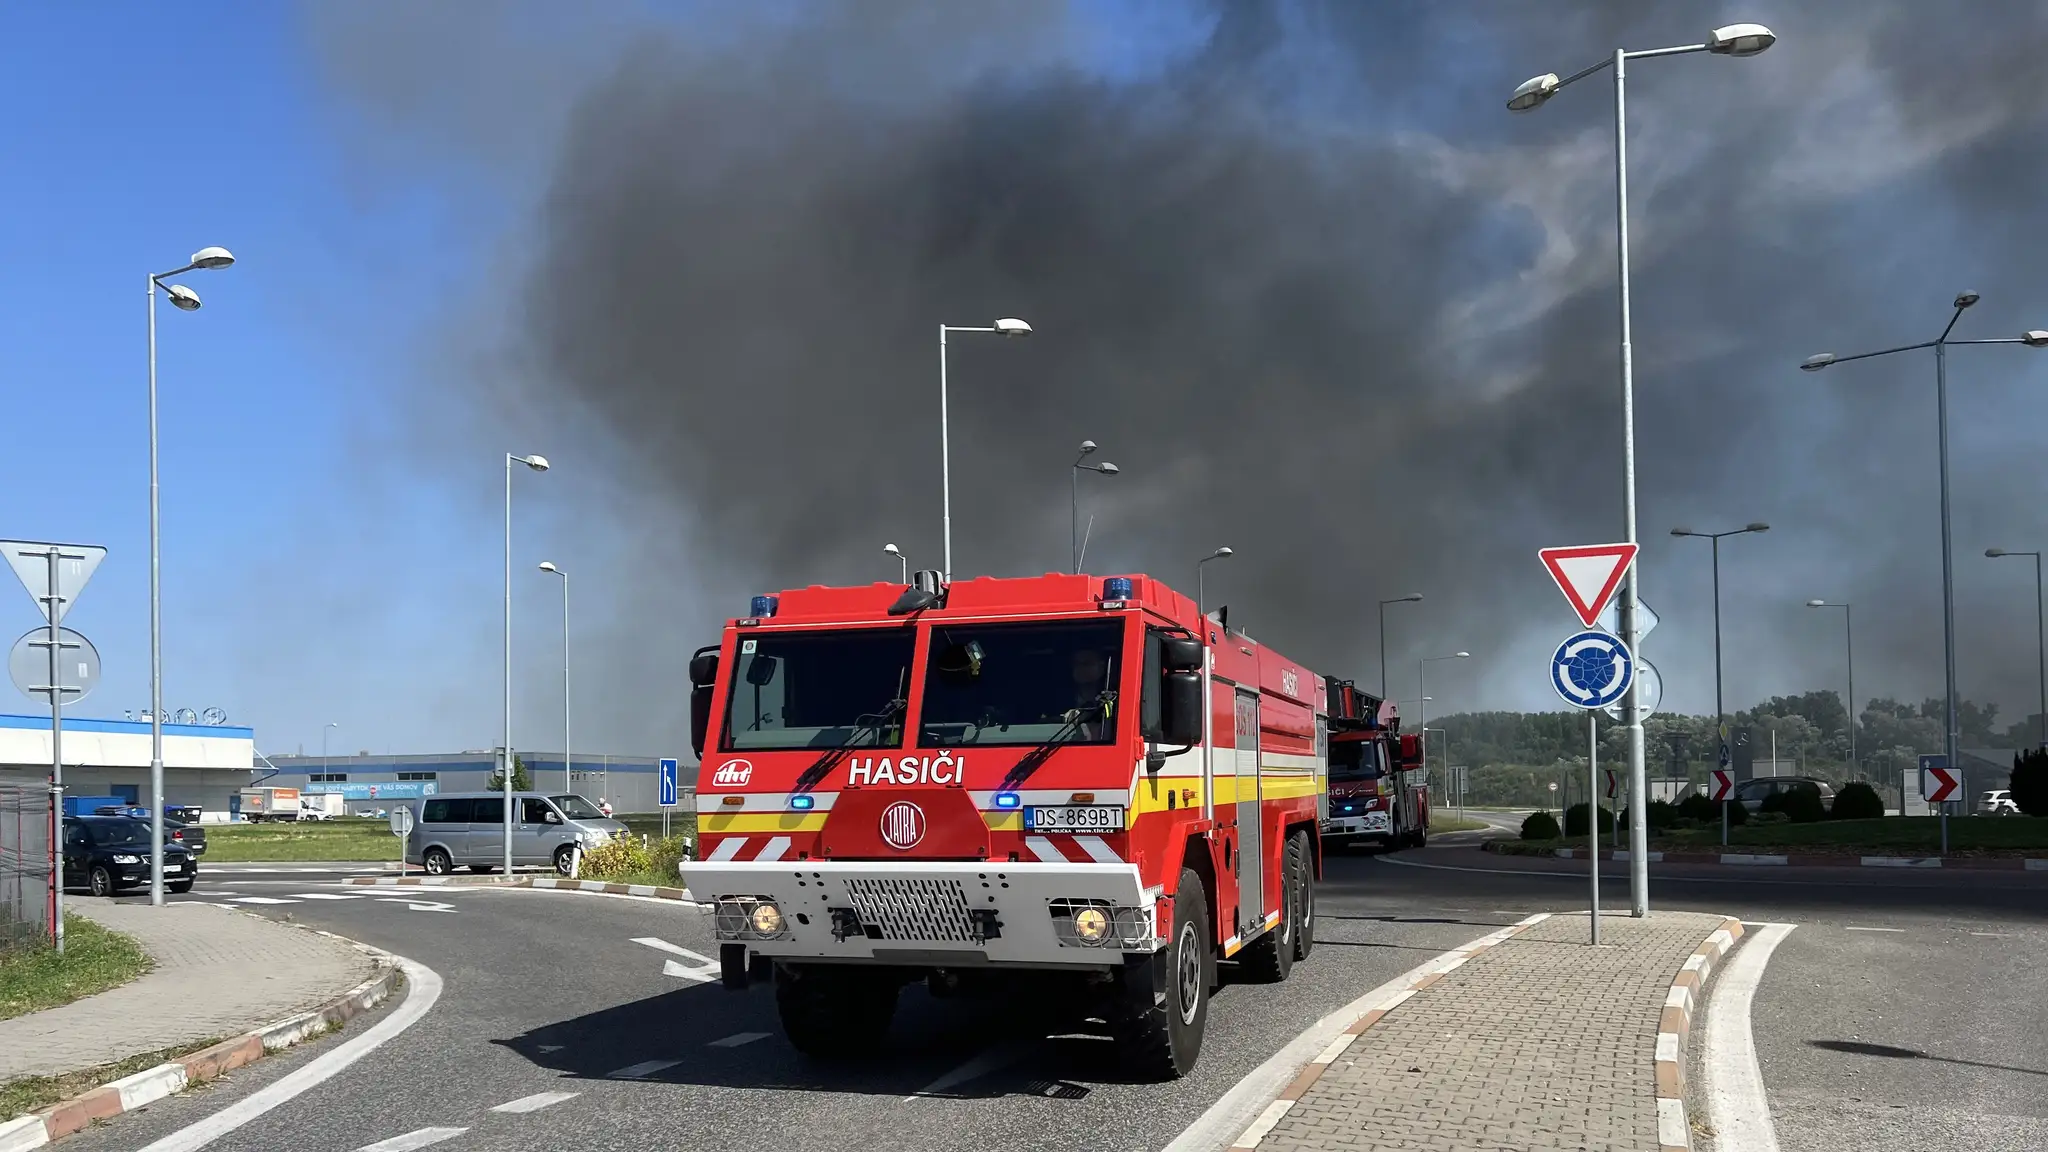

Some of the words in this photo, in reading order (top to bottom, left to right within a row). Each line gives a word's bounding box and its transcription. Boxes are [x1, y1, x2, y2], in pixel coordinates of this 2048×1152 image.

[848, 750, 965, 785] HASIČI
[888, 805, 917, 845] TATRA
[1035, 808, 1120, 826] DS-869BT
